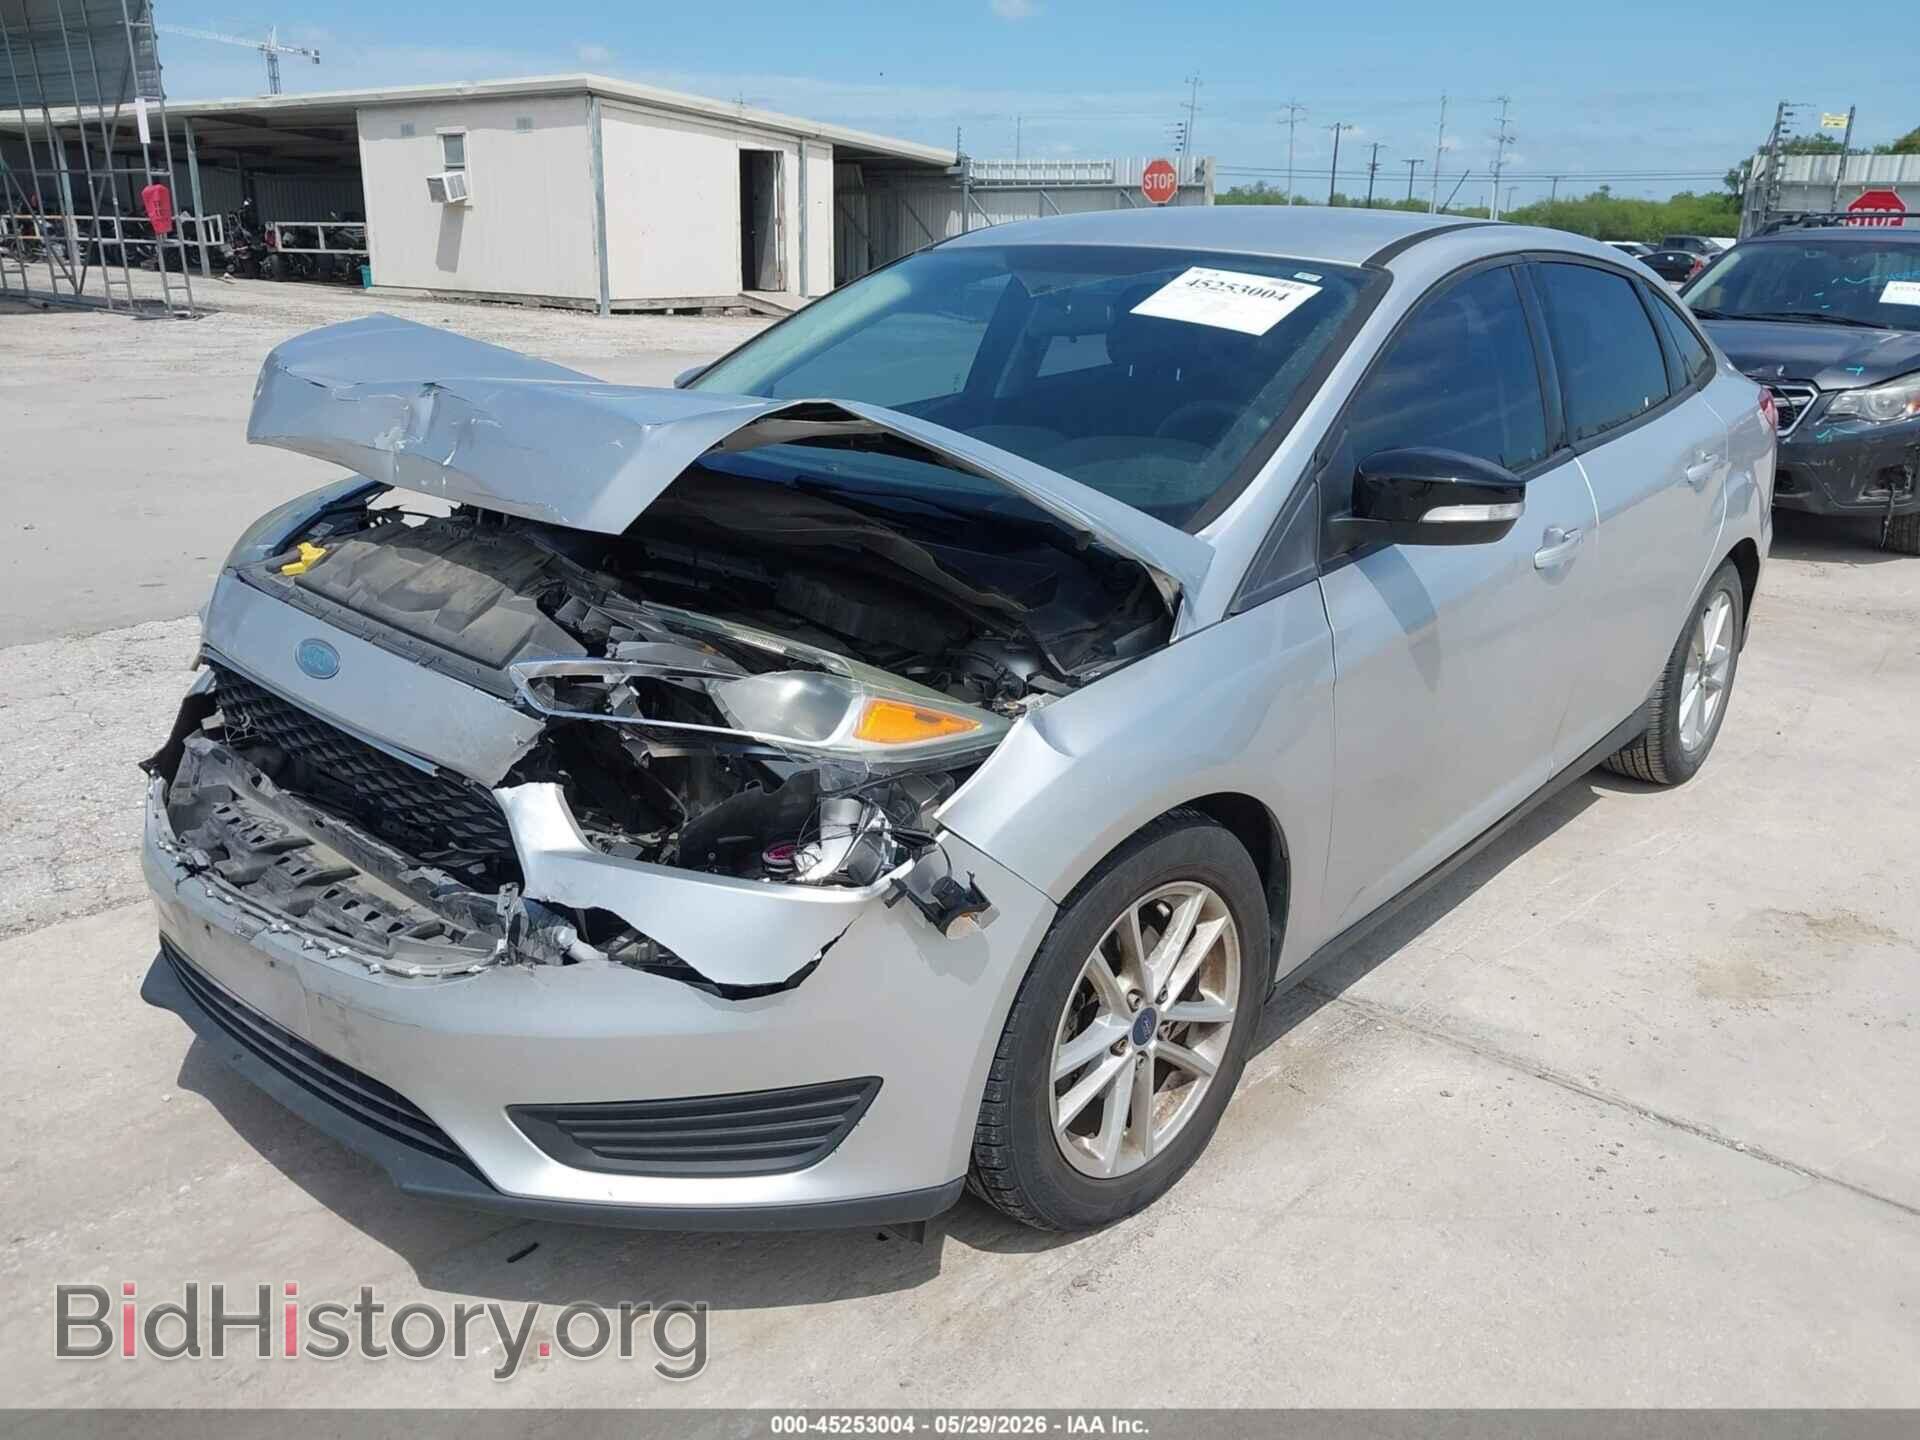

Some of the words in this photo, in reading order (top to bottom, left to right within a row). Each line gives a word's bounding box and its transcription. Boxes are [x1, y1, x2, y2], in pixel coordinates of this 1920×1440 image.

[1144, 173, 1175, 190] STOP
[1849, 208, 1902, 227] STOP
[1186, 278, 1291, 301] 45253004
